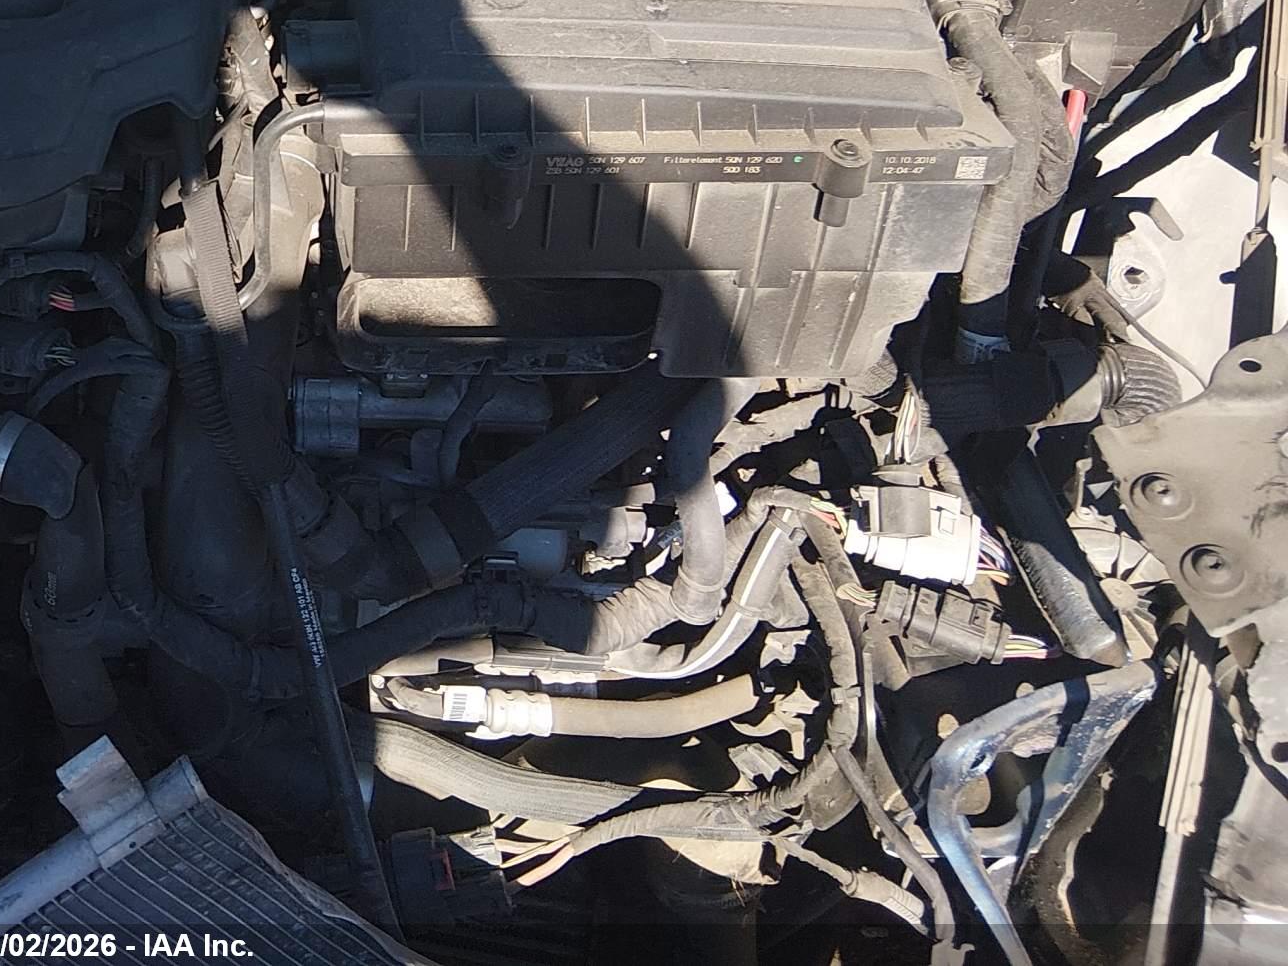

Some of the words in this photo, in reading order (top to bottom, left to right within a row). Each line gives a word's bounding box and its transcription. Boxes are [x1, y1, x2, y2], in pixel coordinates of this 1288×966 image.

[610, 156, 626, 164] 129
[745, 156, 763, 164] 129
[765, 156, 784, 164] 620
